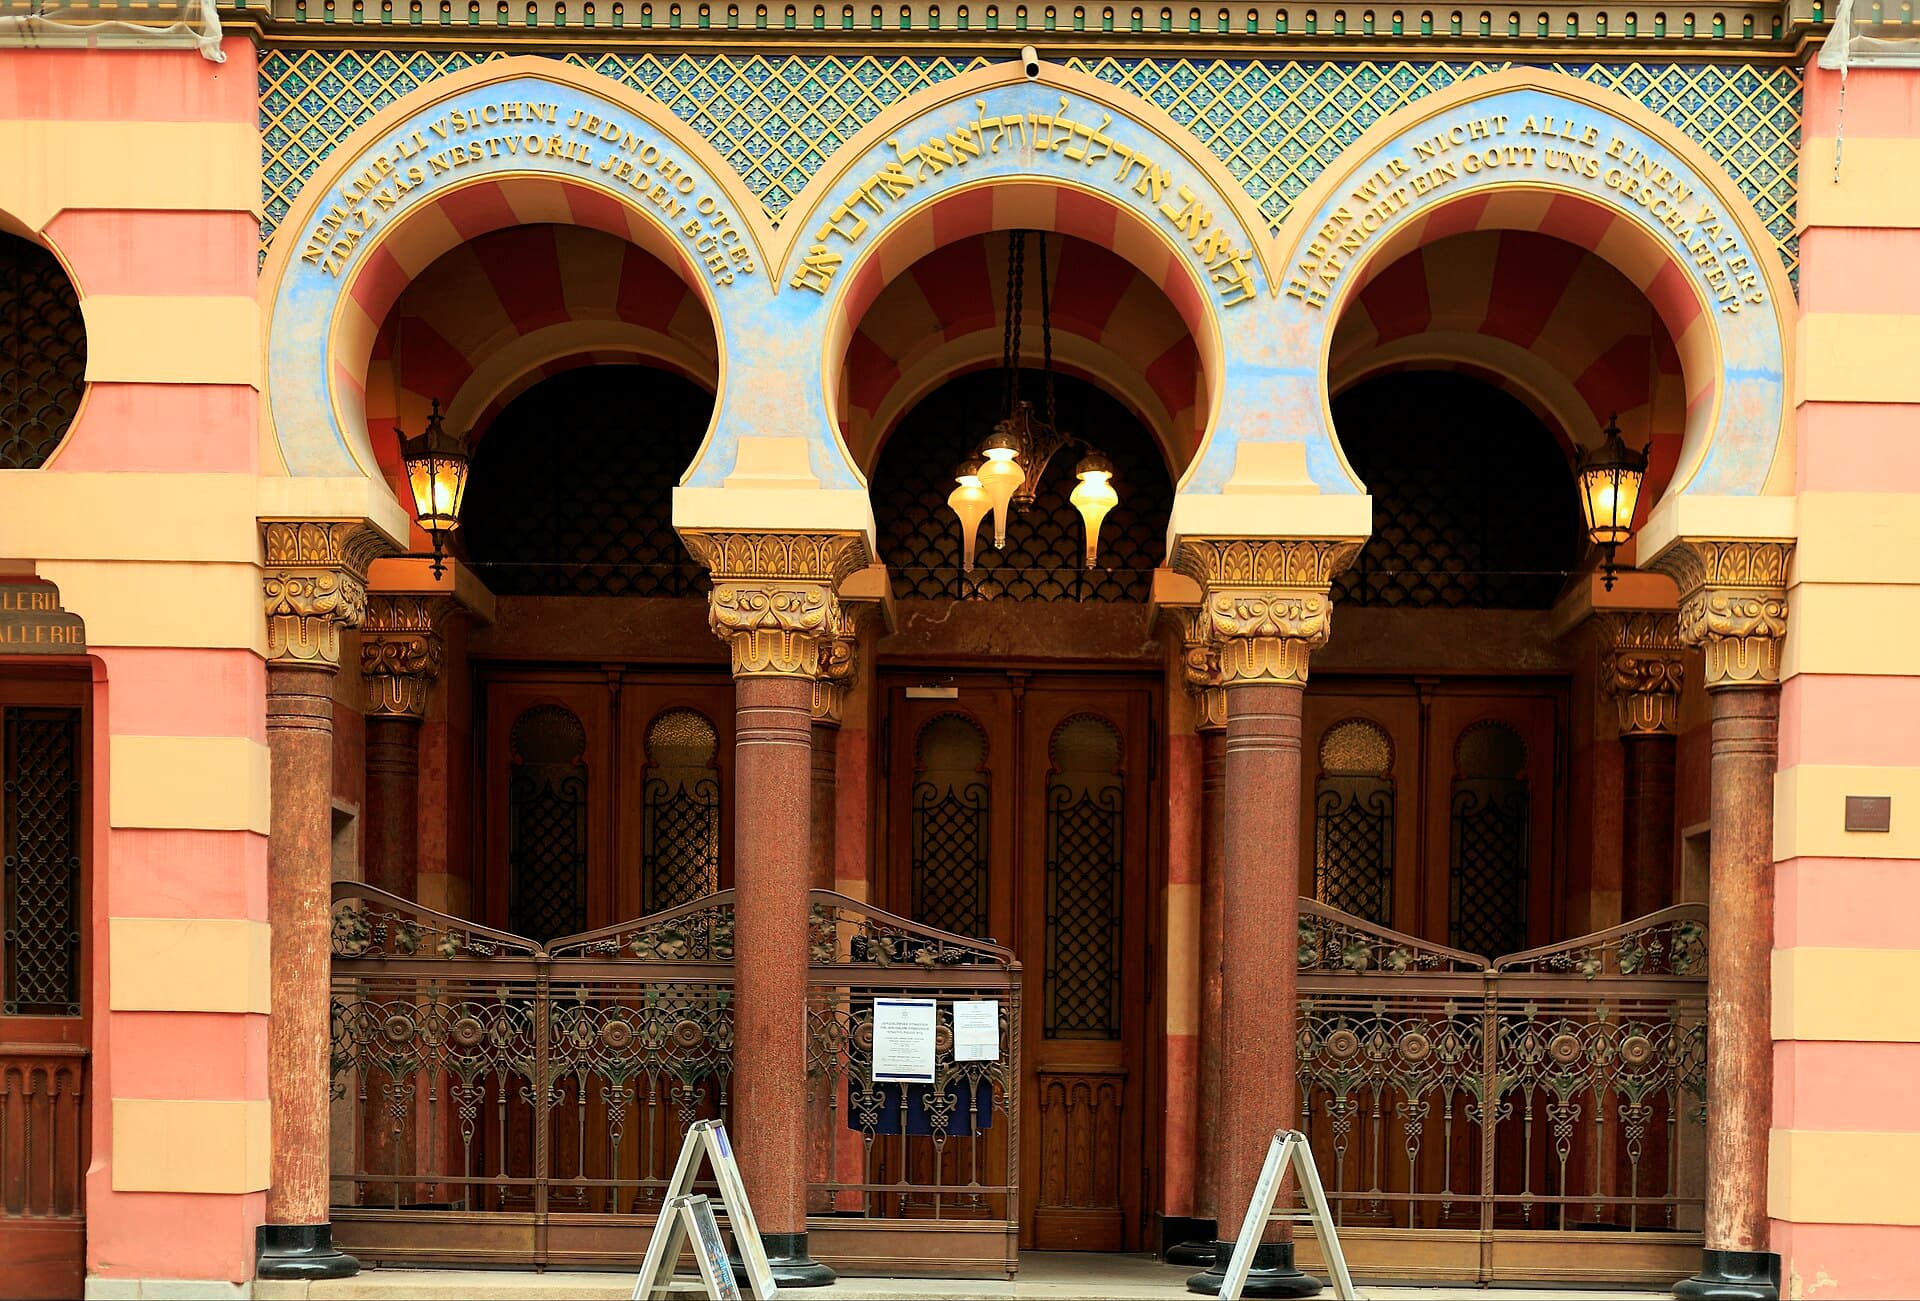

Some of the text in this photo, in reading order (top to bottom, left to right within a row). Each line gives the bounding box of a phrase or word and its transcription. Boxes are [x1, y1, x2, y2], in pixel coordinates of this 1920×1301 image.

[301, 101, 756, 274] NEMÁME-LI VŠICHNI JEDNOHO OTCE?
[321, 135, 735, 286] ZDAŽ NÁS NESTVOŘIL JEDEN BŮH?
[1113, 141, 1172, 203] אחד
[1159, 184, 1212, 240] אב
[1286, 114, 1764, 304] HABEN WIR NICHT ALLE EINEN VATER?
[1305, 146, 1741, 314] HAT NICHT EIN GOTT UNS GESCHAFFEN?
